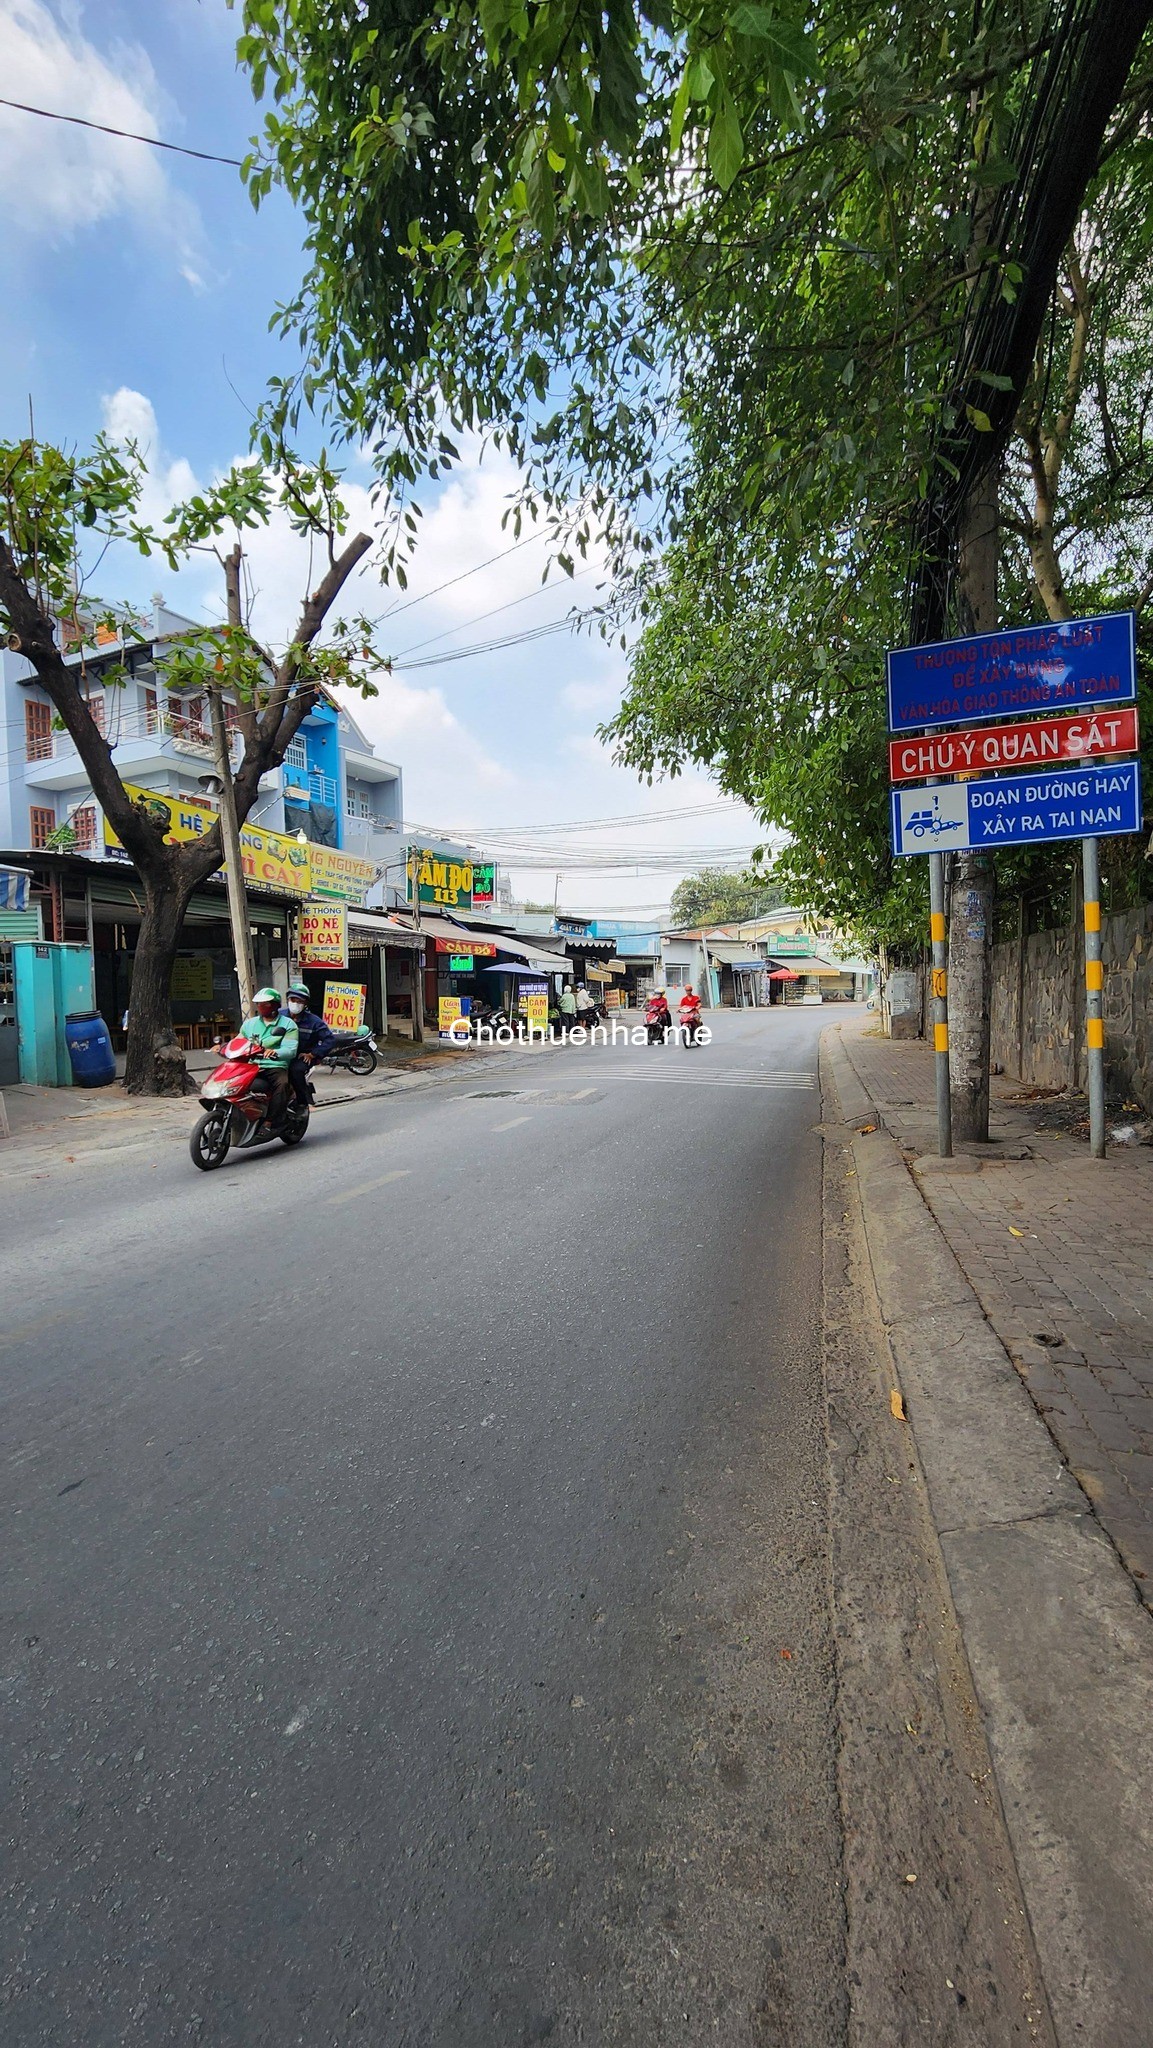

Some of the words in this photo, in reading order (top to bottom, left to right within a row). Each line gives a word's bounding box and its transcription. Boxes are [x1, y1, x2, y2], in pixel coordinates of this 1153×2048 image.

[981, 638, 1012, 660] TÔN
[1016, 631, 1058, 653] PHÁP
[979, 665, 1013, 685] XÂY
[964, 694, 999, 711] GIAO
[1001, 683, 1051, 705] THÔNG
[1055, 681, 1076, 698] AN
[901, 736, 954, 774] CHÚ
[960, 733, 977, 766] Ý
[982, 729, 1060, 762] QUAN
[1067, 716, 1122, 751] SÁT
[970, 788, 1021, 809] ĐOẠN
[1025, 780, 1090, 801] ĐƯỜNG
[1095, 775, 1132, 795] HAY
[180, 812, 204, 837] HỆ
[982, 814, 1017, 836] XẢY
[1021, 813, 1045, 832] RA
[1049, 811, 1075, 829] TAI
[1081, 805, 1122, 827] NẠN
[262, 862, 303, 887] CAY
[434, 887, 458, 905] 113
[300, 906, 311, 914] HỆ
[313, 905, 342, 915] THỐNG
[303, 914, 319, 930] BÒ
[322, 914, 339, 929] NÉ
[300, 929, 314, 944] MÌ
[318, 932, 342, 944] CAY
[445, 940, 472, 954] CẦM
[326, 985, 335, 993] HỆ
[337, 986, 359, 996] THỐNG
[327, 995, 340, 1010] BÒ
[342, 996, 355, 1011] NÉ
[323, 1010, 335, 1025] MÌ
[336, 1014, 357, 1028] CAY
